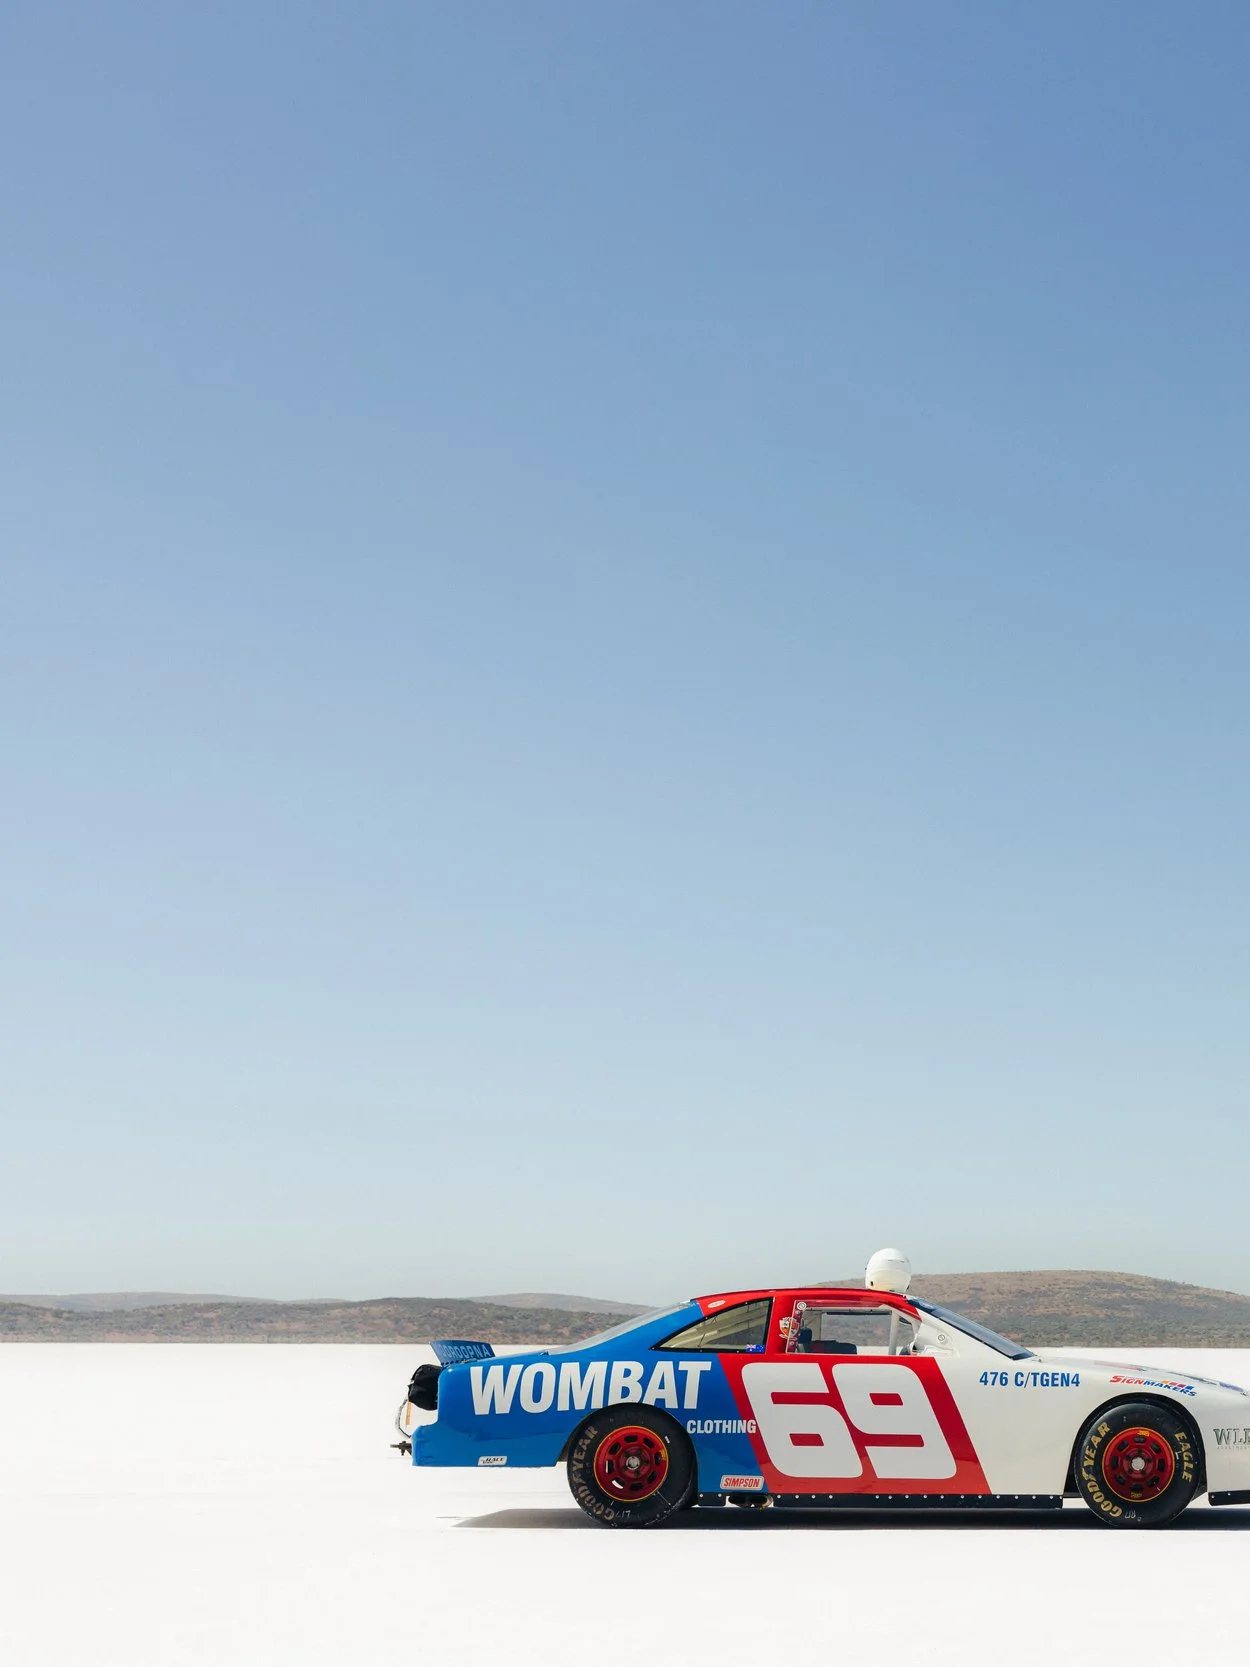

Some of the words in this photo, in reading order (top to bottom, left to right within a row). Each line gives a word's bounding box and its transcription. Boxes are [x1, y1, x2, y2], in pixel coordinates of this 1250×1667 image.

[470, 1361, 711, 1416] WOMBAT
[979, 1371, 1008, 1387] 476
[1014, 1371, 1080, 1388] C/TGEN4
[686, 1419, 757, 1434] CLOTHING
[741, 1362, 957, 1480] 69
[723, 1477, 760, 1488] SIMPSON
[1081, 1422, 1123, 1517] GOODYEAR
[1175, 1431, 1194, 1483] EAGLE
